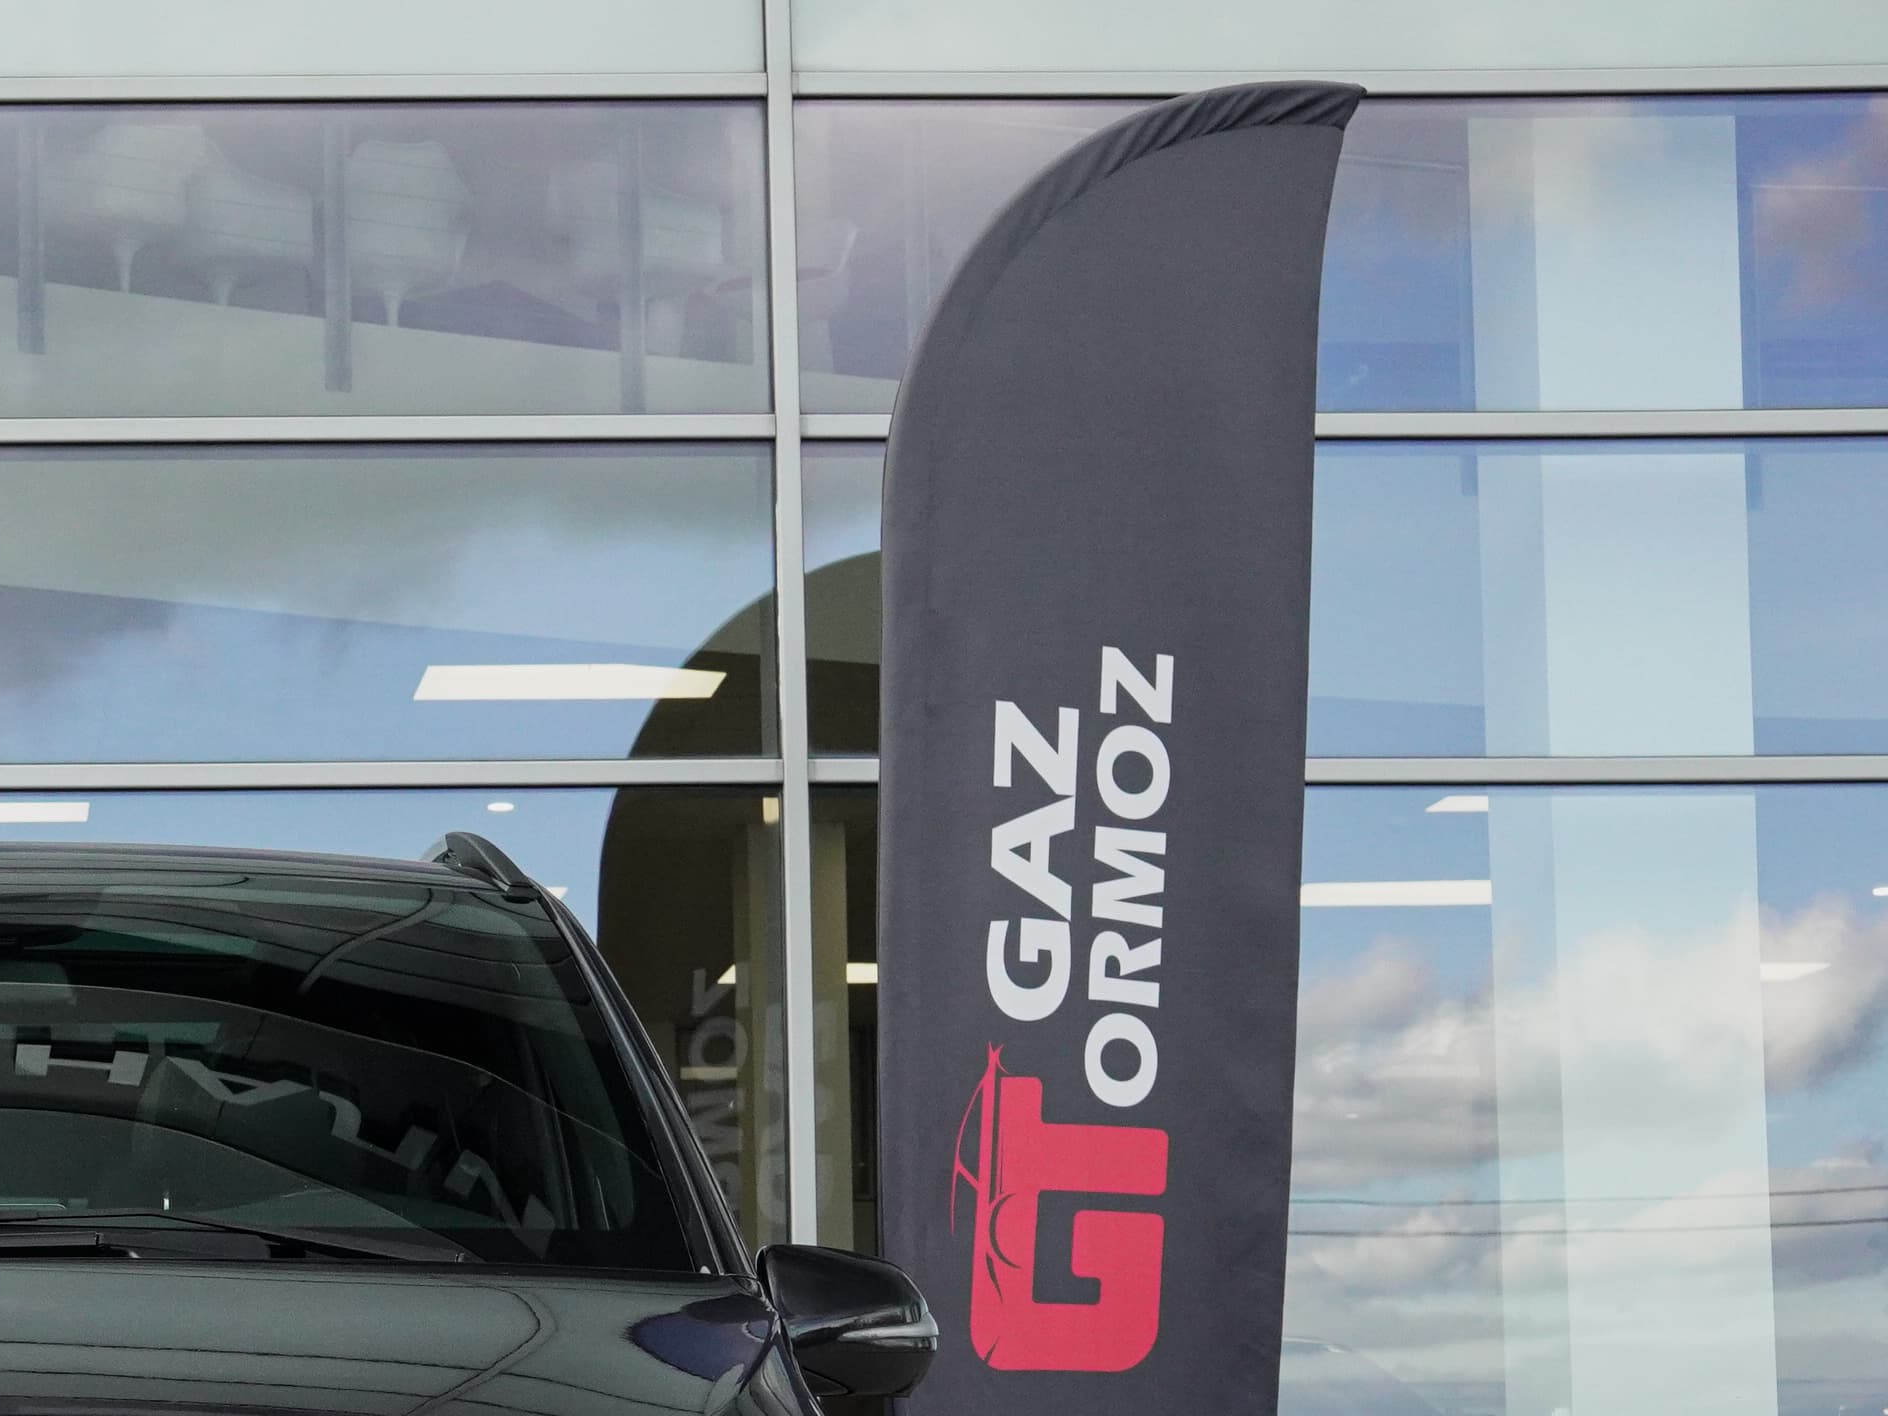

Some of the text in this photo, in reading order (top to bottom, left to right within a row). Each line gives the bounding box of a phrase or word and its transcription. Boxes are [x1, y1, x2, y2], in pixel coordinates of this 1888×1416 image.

[986, 700, 1080, 1022] GAZ
[1084, 646, 1174, 1107] ORMOZ
[969, 1060, 1170, 1373] GT
